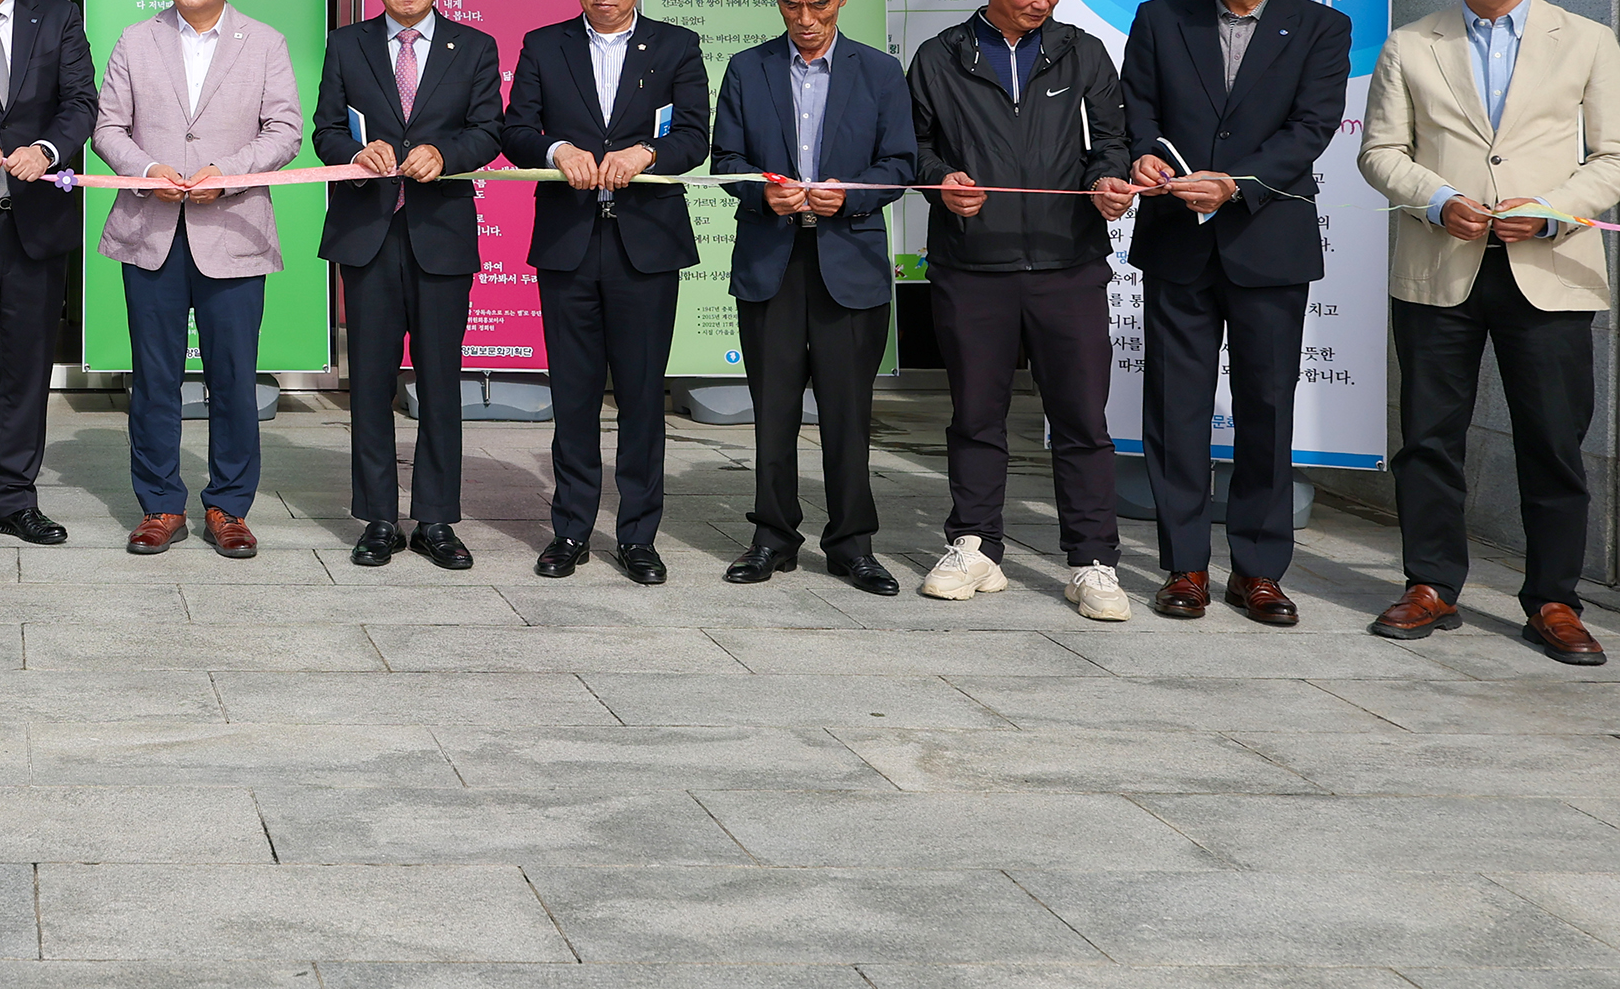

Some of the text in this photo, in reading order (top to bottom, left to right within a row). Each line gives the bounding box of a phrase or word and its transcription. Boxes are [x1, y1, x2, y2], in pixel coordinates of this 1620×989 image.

[136, 0, 146, 10] 다
[452, 11, 484, 22] 봅니다.
[680, 16, 706, 26] 들었다
[716, 34, 741, 44] 바다의
[715, 52, 725, 62] 온
[693, 198, 717, 207] 가르던
[694, 216, 711, 225] 품고
[478, 273, 518, 285] 할까봐서
